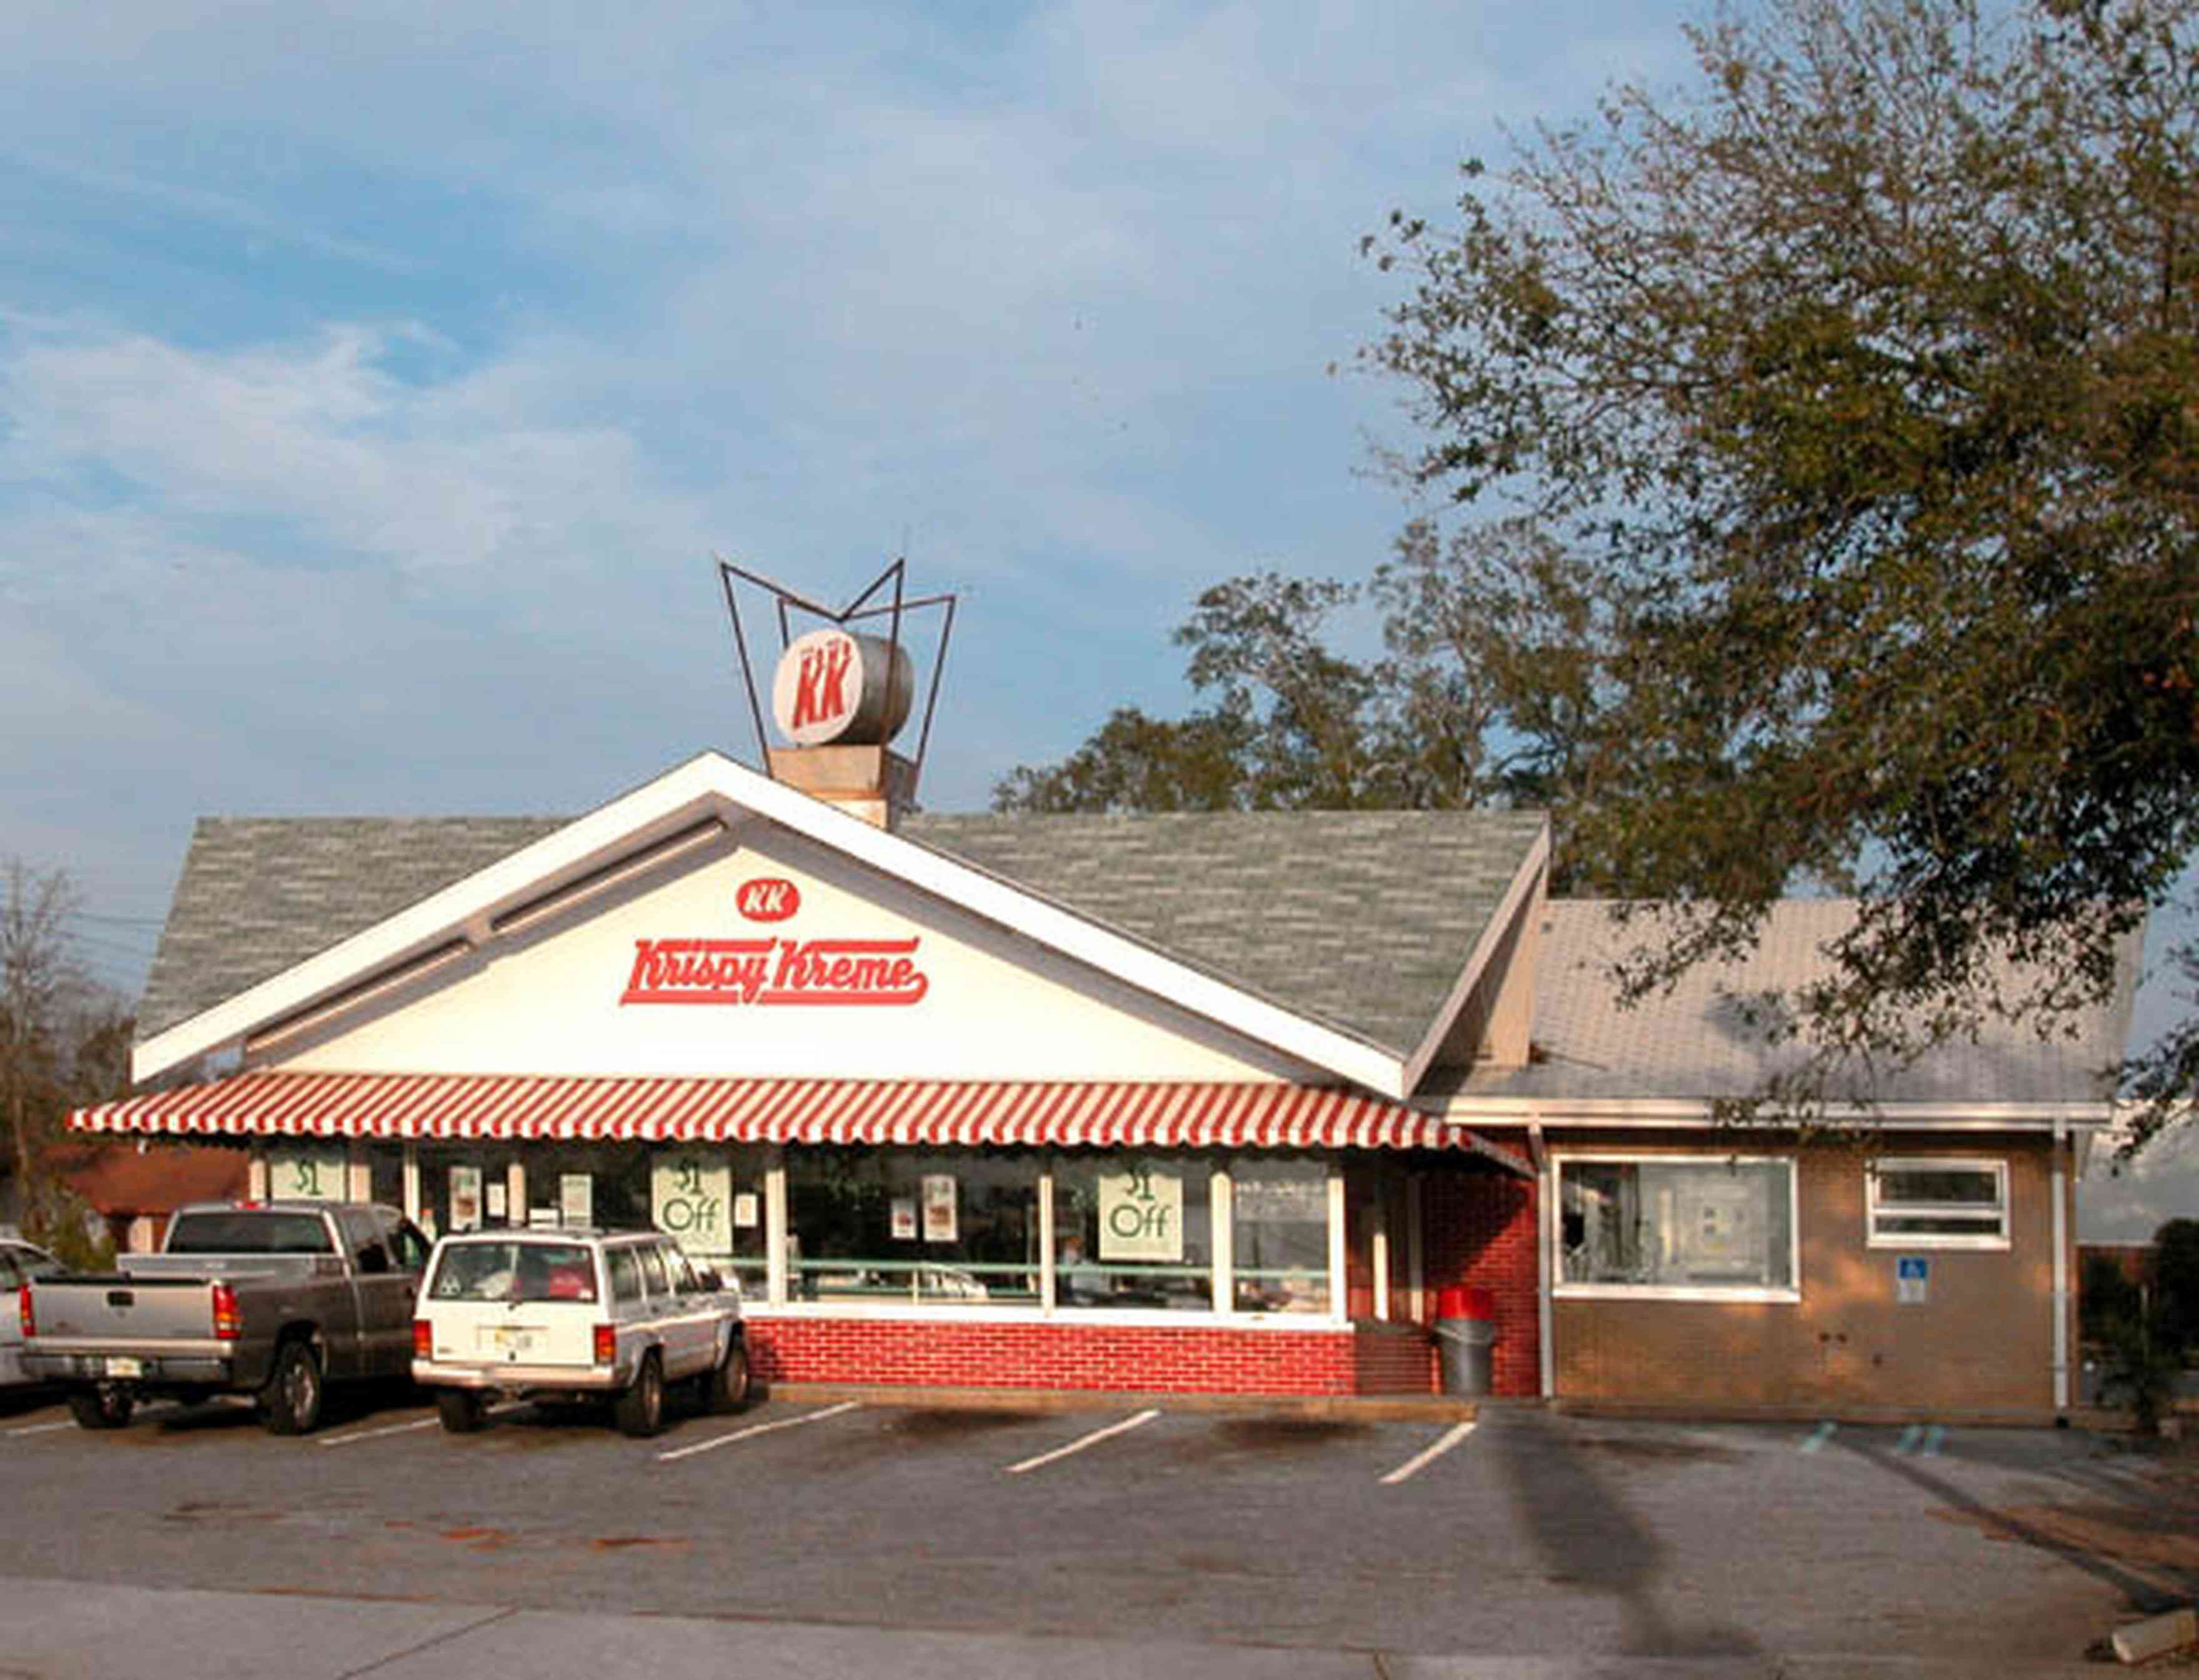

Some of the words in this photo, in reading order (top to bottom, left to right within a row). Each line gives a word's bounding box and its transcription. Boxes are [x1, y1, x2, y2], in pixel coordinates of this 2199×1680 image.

[745, 882, 789, 912] KK
[623, 937, 777, 1005] Krispy
[772, 937, 928, 1006] Kreme
[663, 1197, 720, 1231] Off
[1109, 1203, 1172, 1238] Off
